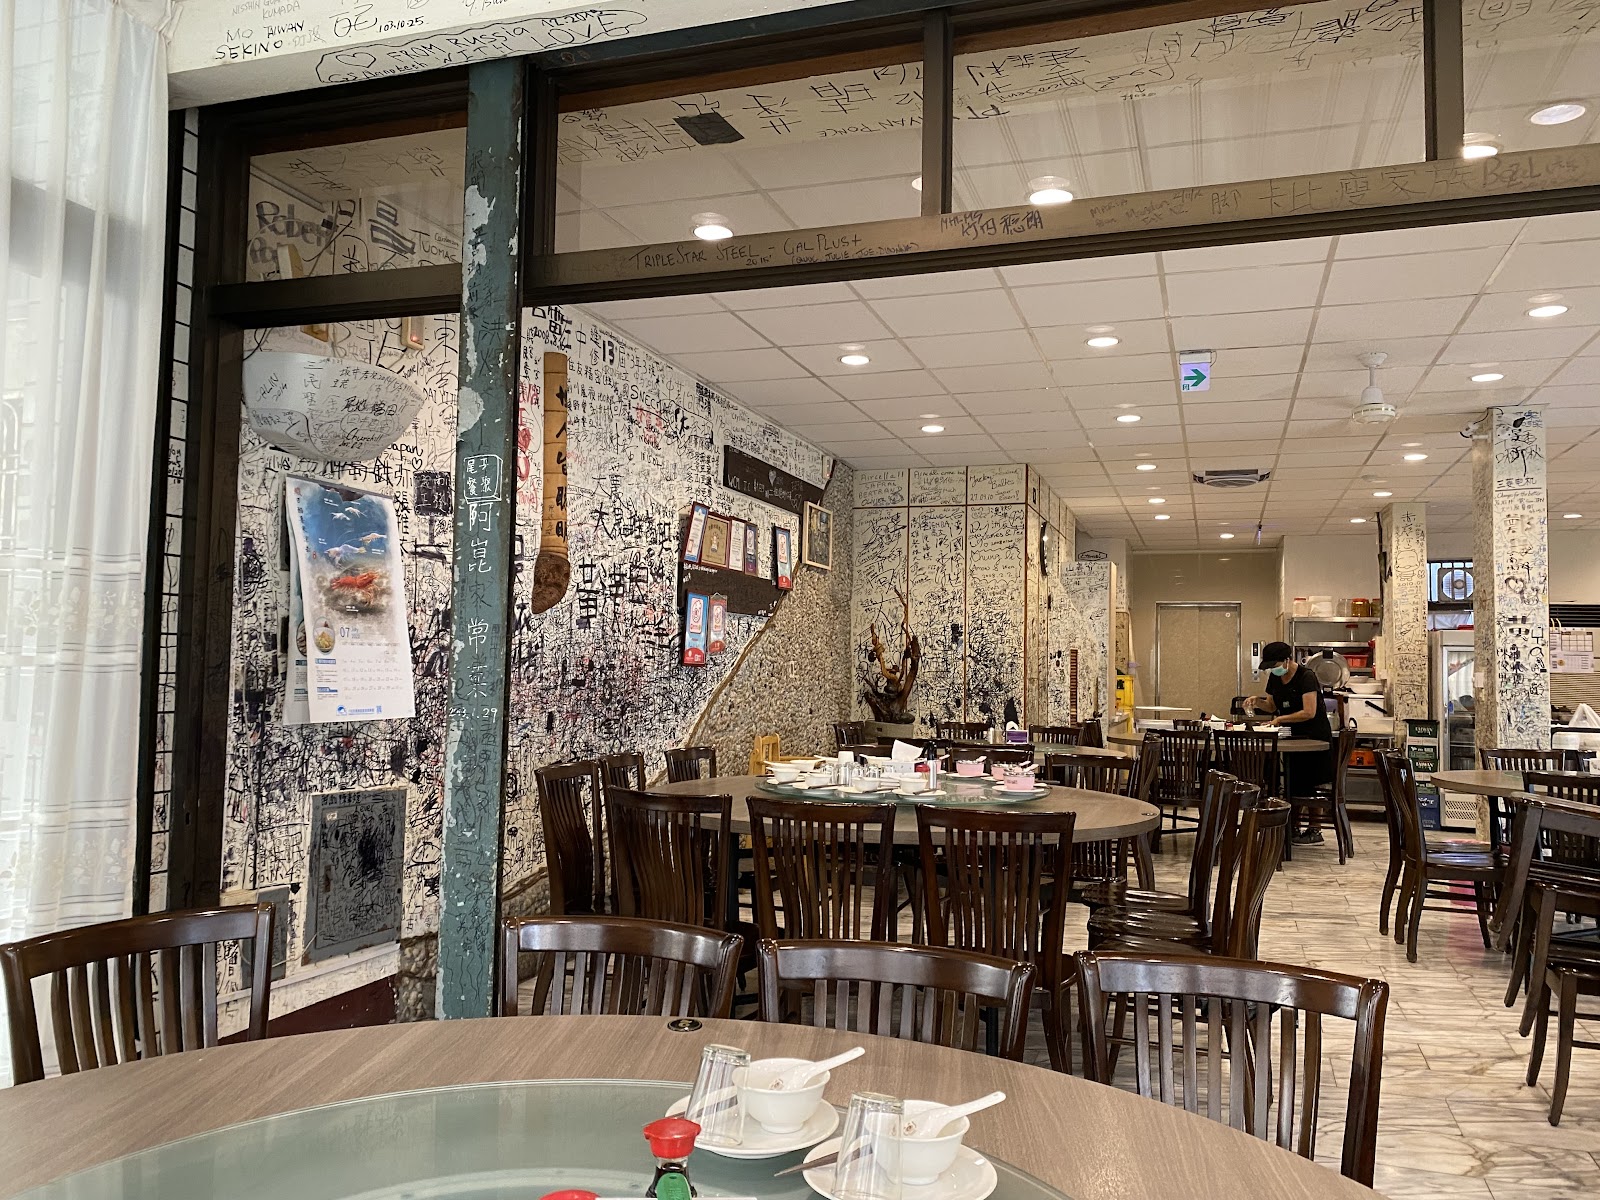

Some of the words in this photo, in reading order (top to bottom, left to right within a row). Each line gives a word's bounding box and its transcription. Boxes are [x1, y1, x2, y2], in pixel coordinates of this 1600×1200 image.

[531, 13, 617, 49] LOVE
[215, 40, 284, 60] SEKINO
[387, 43, 446, 66] FROM
[878, 117, 922, 130] YAN
[716, 242, 760, 261] STEEL
[345, 427, 383, 441] Churchill
[340, 626, 350, 638] 07
